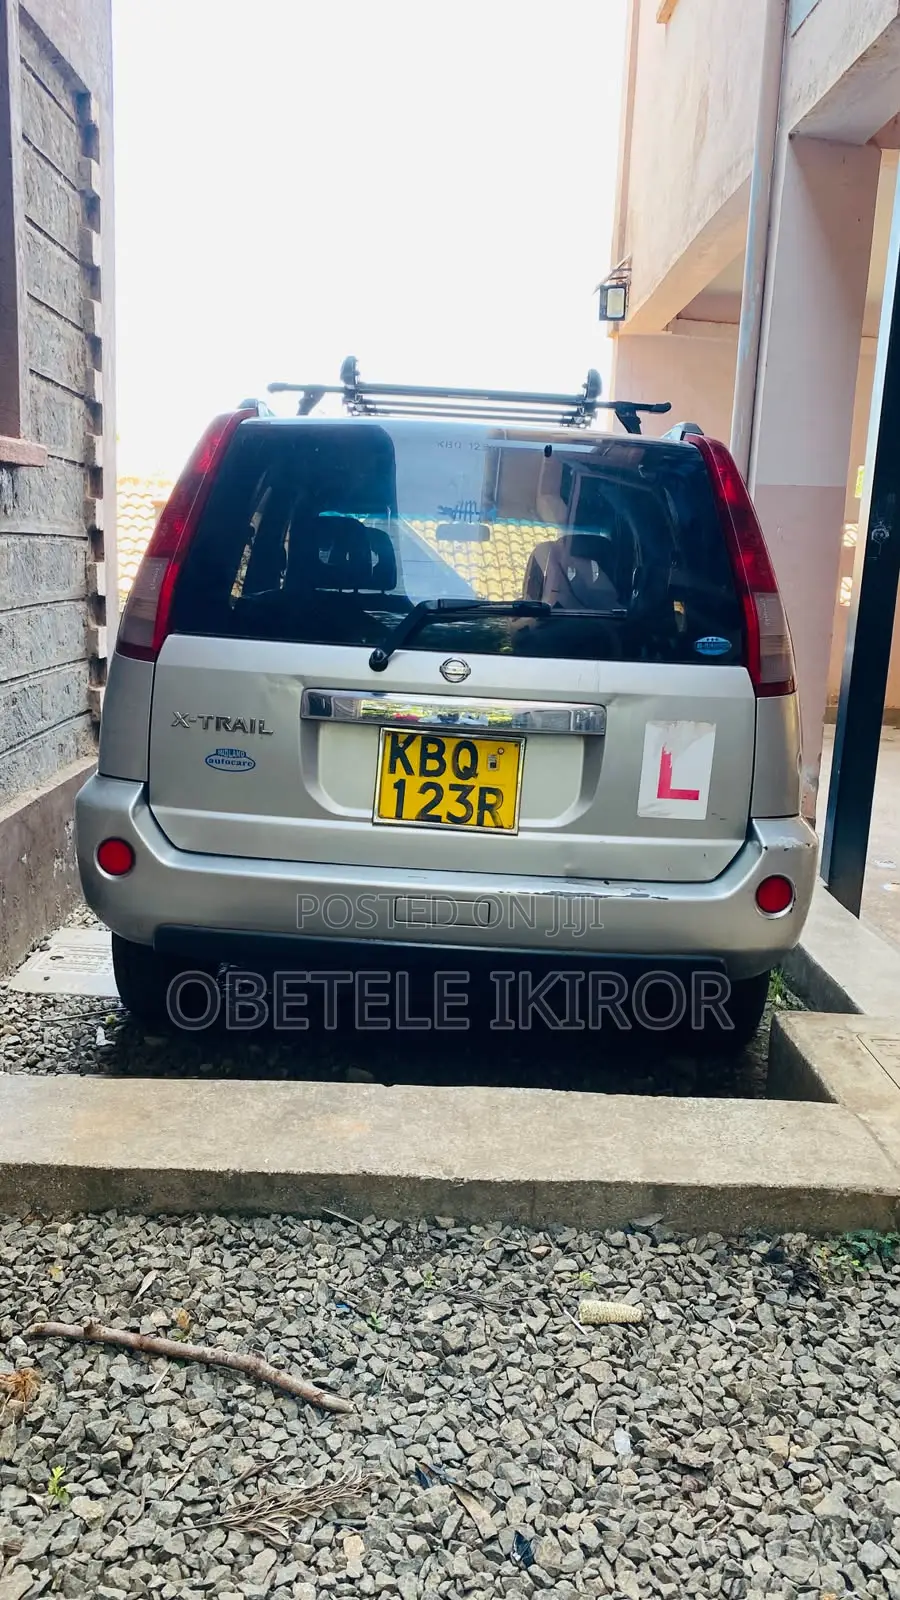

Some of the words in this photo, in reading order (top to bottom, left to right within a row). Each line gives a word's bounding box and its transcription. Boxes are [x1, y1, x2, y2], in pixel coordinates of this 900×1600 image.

[171, 711, 274, 735] X-TRAIL
[208, 757, 253, 767] autocare
[388, 734, 479, 780] KBQ
[656, 746, 700, 801] L
[393, 778, 504, 828] 123R
